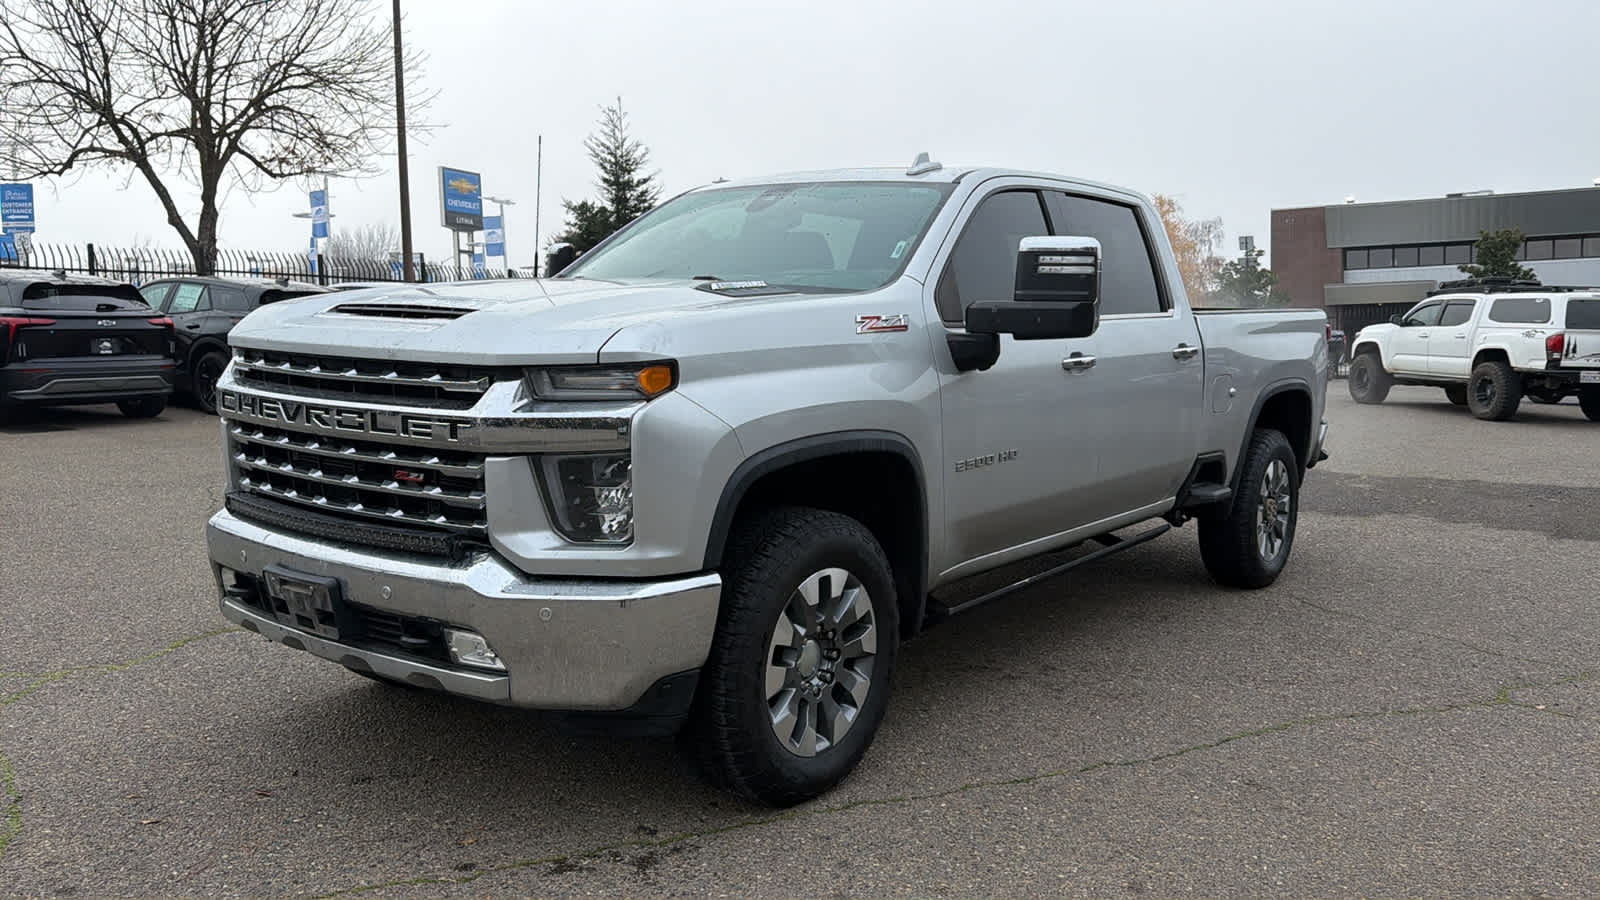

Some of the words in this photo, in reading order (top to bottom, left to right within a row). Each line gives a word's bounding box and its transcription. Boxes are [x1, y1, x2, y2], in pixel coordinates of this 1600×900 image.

[447, 199, 480, 209] CHEVROLET
[856, 313, 909, 334] Z71
[220, 391, 471, 442] CHEVROLET
